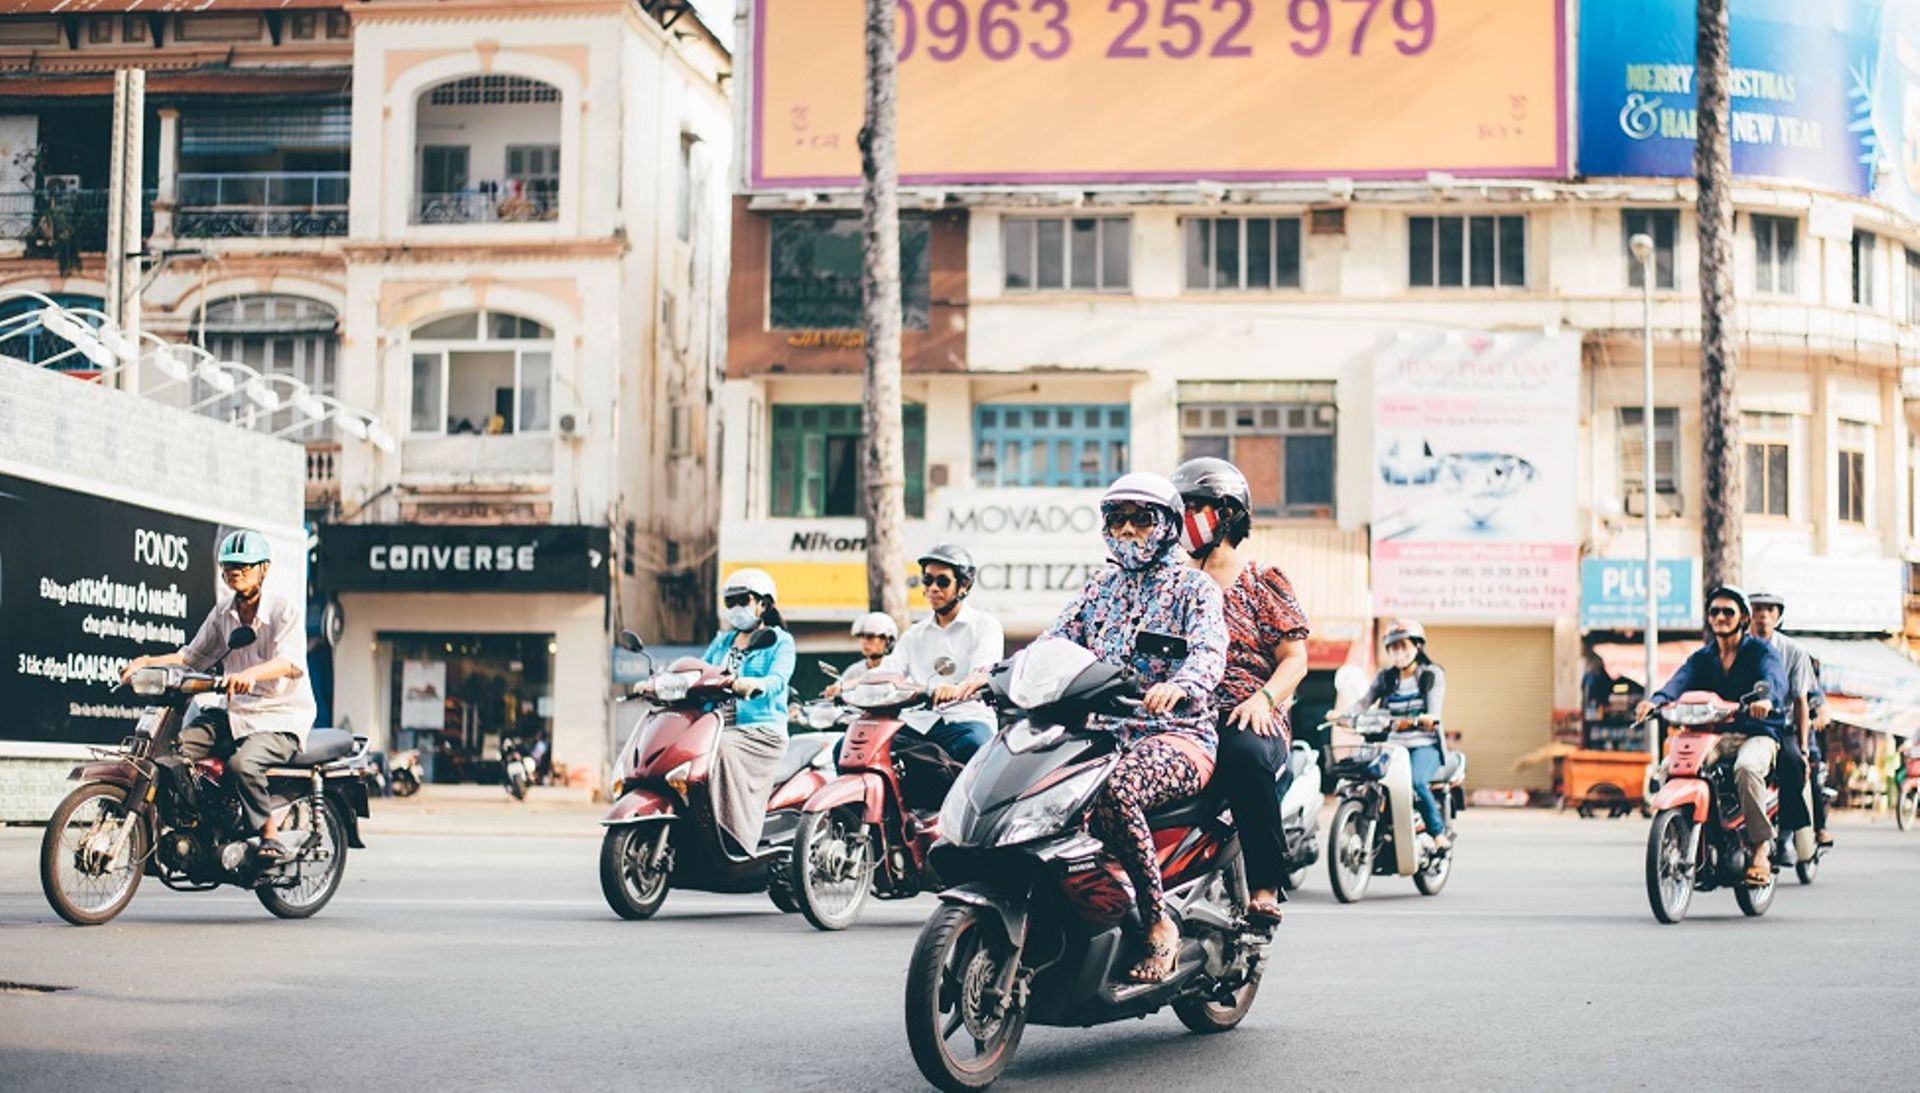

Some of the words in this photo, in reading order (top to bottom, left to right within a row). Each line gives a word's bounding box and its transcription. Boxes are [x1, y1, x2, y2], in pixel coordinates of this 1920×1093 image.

[1105, 0, 1253, 59] 252
[1287, 0, 1436, 58] 979
[1626, 64, 1694, 94] MERRY
[1728, 67, 1796, 101] RISTMAS
[1619, 92, 1663, 140] &
[1661, 108, 1698, 140] HAP
[1732, 111, 1774, 145] NEW
[1776, 115, 1823, 149] YEAR
[947, 505, 1097, 534] MOVADO
[790, 531, 868, 552] Nikon
[369, 544, 535, 571] CONVERSE
[977, 562, 1106, 591] CITIZE
[1602, 567, 1673, 599] PLUS
[80, 574, 114, 608] KHÓI
[137, 581, 148, 613] Ô
[17, 652, 26, 674] 3
